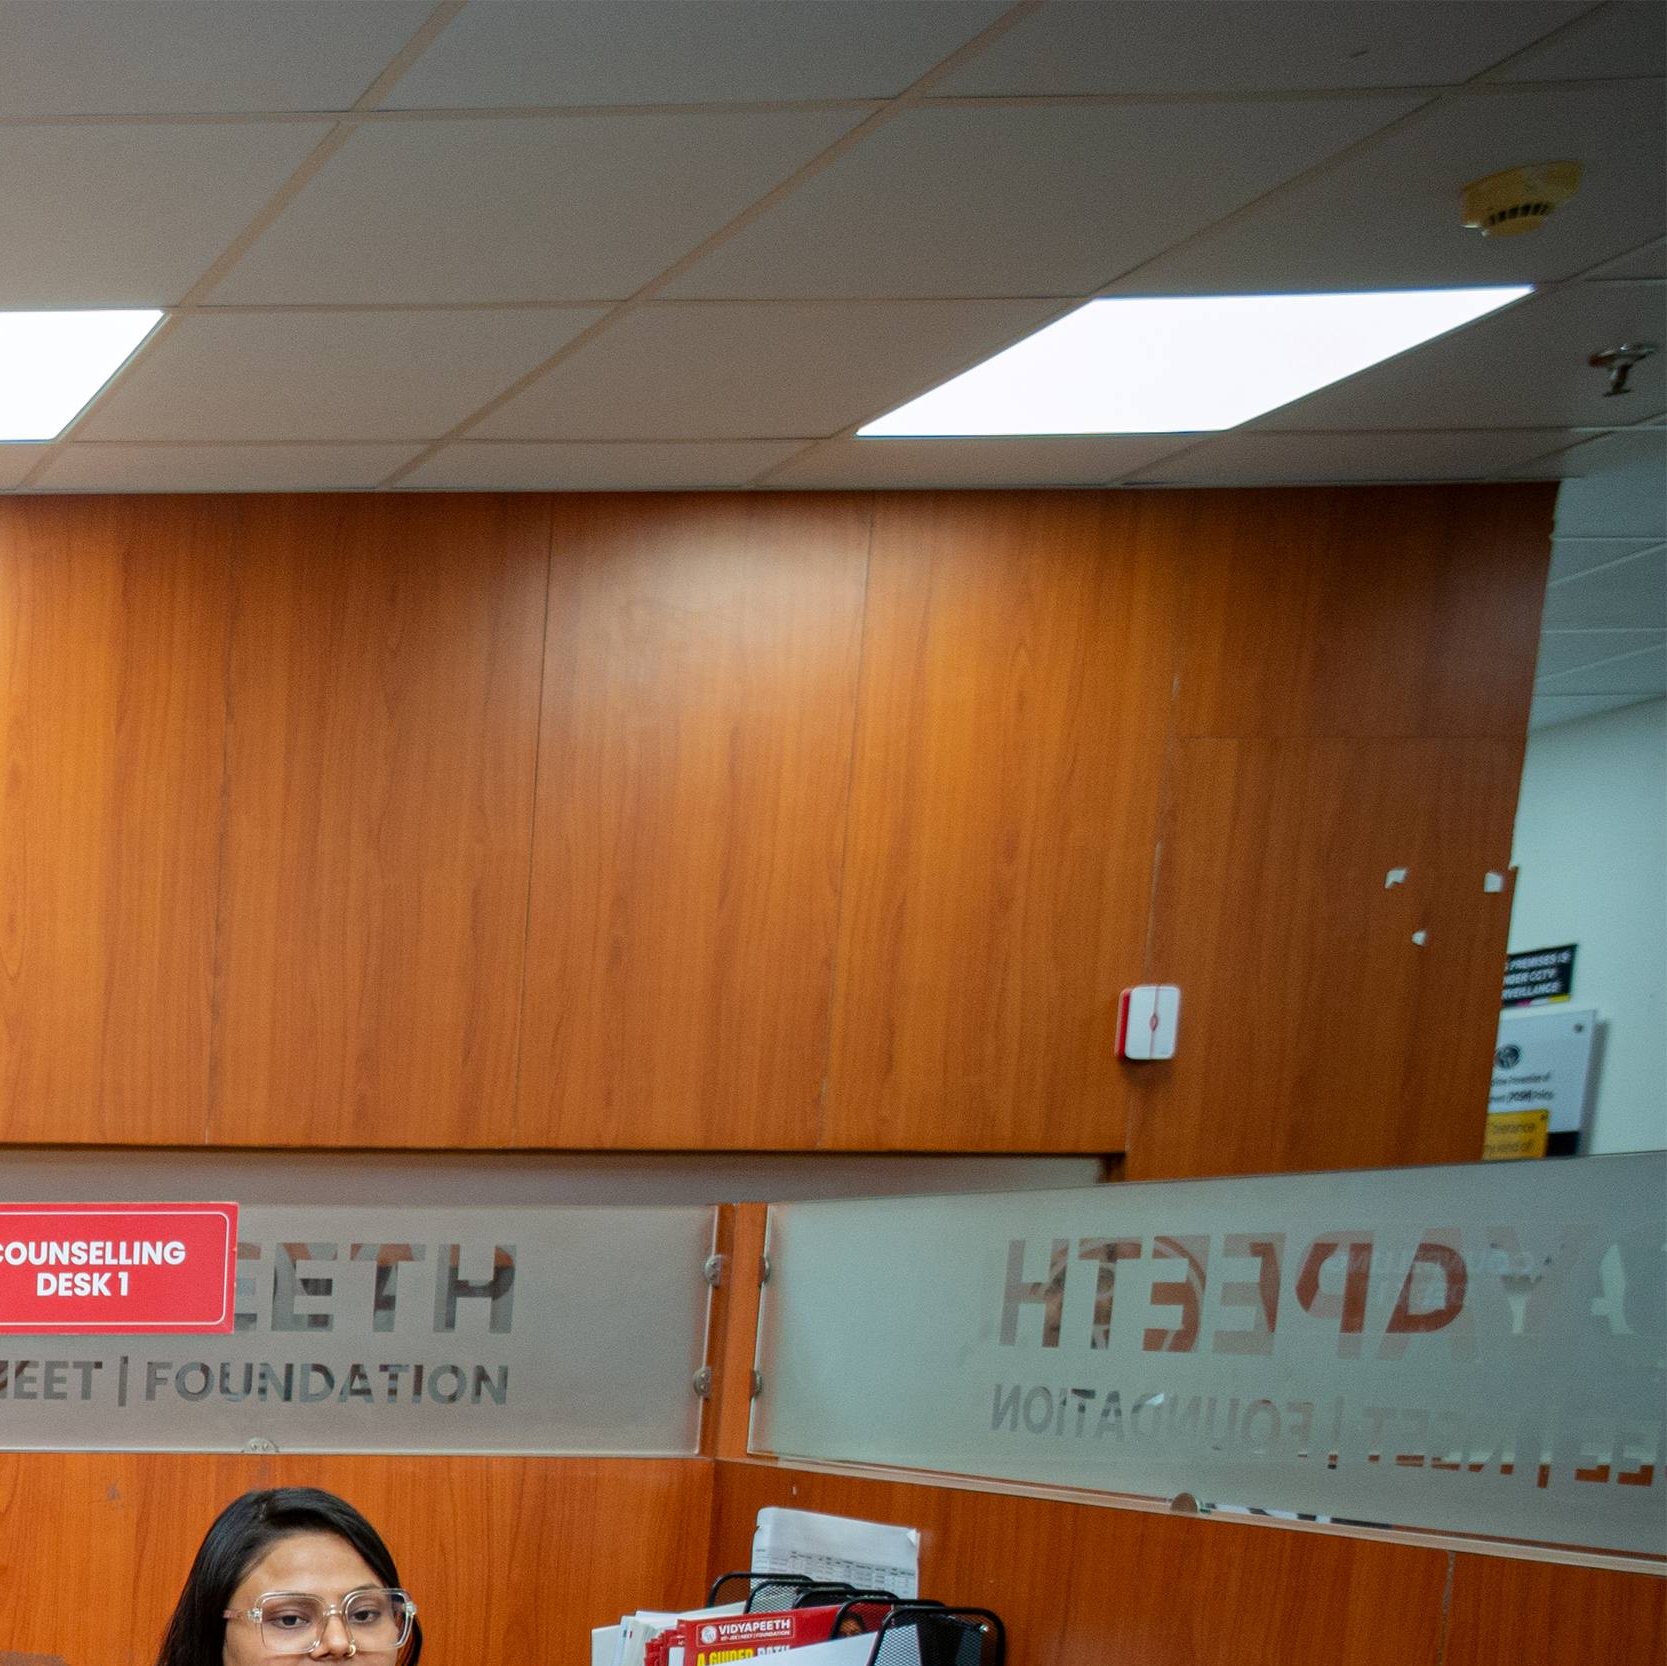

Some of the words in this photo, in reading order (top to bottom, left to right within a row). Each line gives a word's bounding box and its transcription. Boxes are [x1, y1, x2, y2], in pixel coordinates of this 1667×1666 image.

[36, 1272, 111, 1297] DESK
[117, 1271, 129, 1296] 1
[145, 1360, 510, 1405] FOUNDATION
[718, 1618, 791, 1635] VIDYAPEETH
